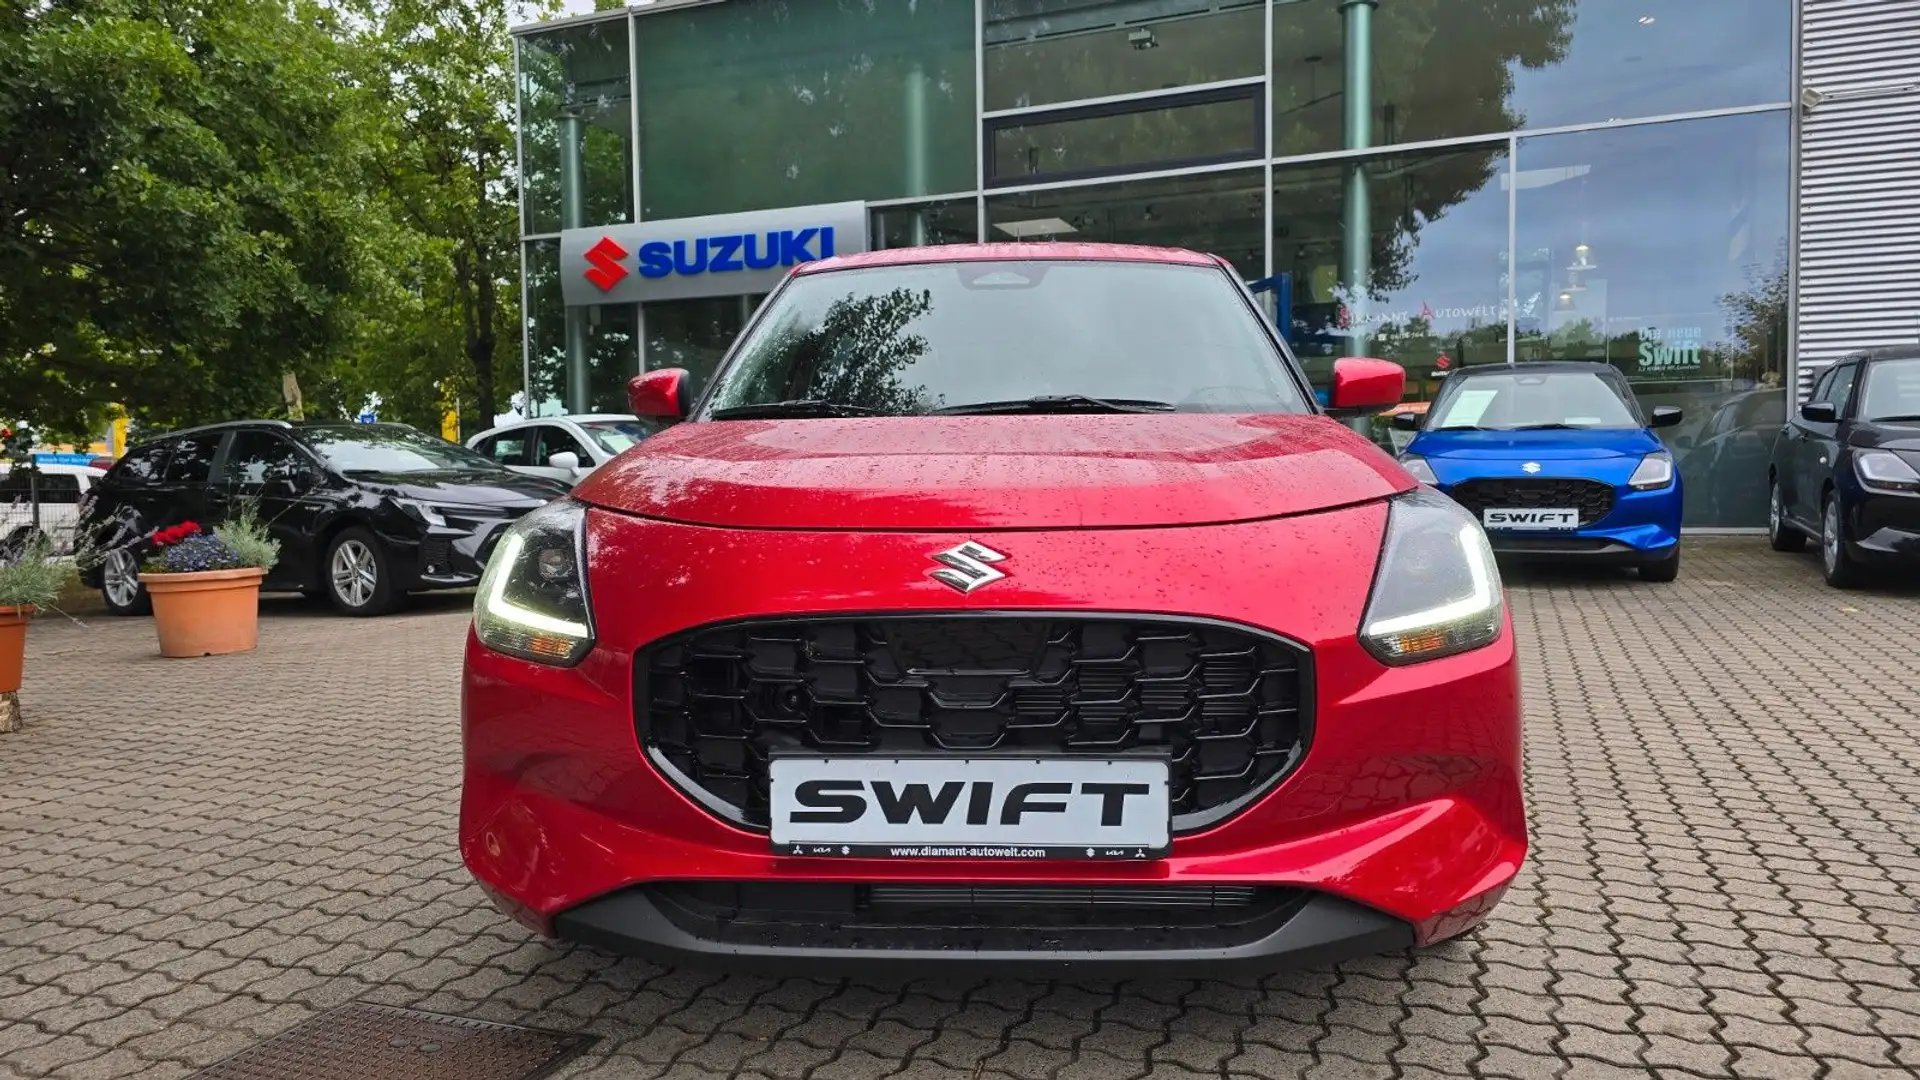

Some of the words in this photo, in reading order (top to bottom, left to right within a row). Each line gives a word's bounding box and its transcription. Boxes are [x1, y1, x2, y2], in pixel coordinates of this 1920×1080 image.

[638, 226, 834, 278] SUZUKI
[1668, 326, 1702, 341] neue
[1638, 340, 1701, 366] Swift
[1488, 513, 1575, 523] SWIFT
[789, 779, 1150, 827] SWIFT
[890, 845, 1046, 858] www.diamant-autowelt.com
